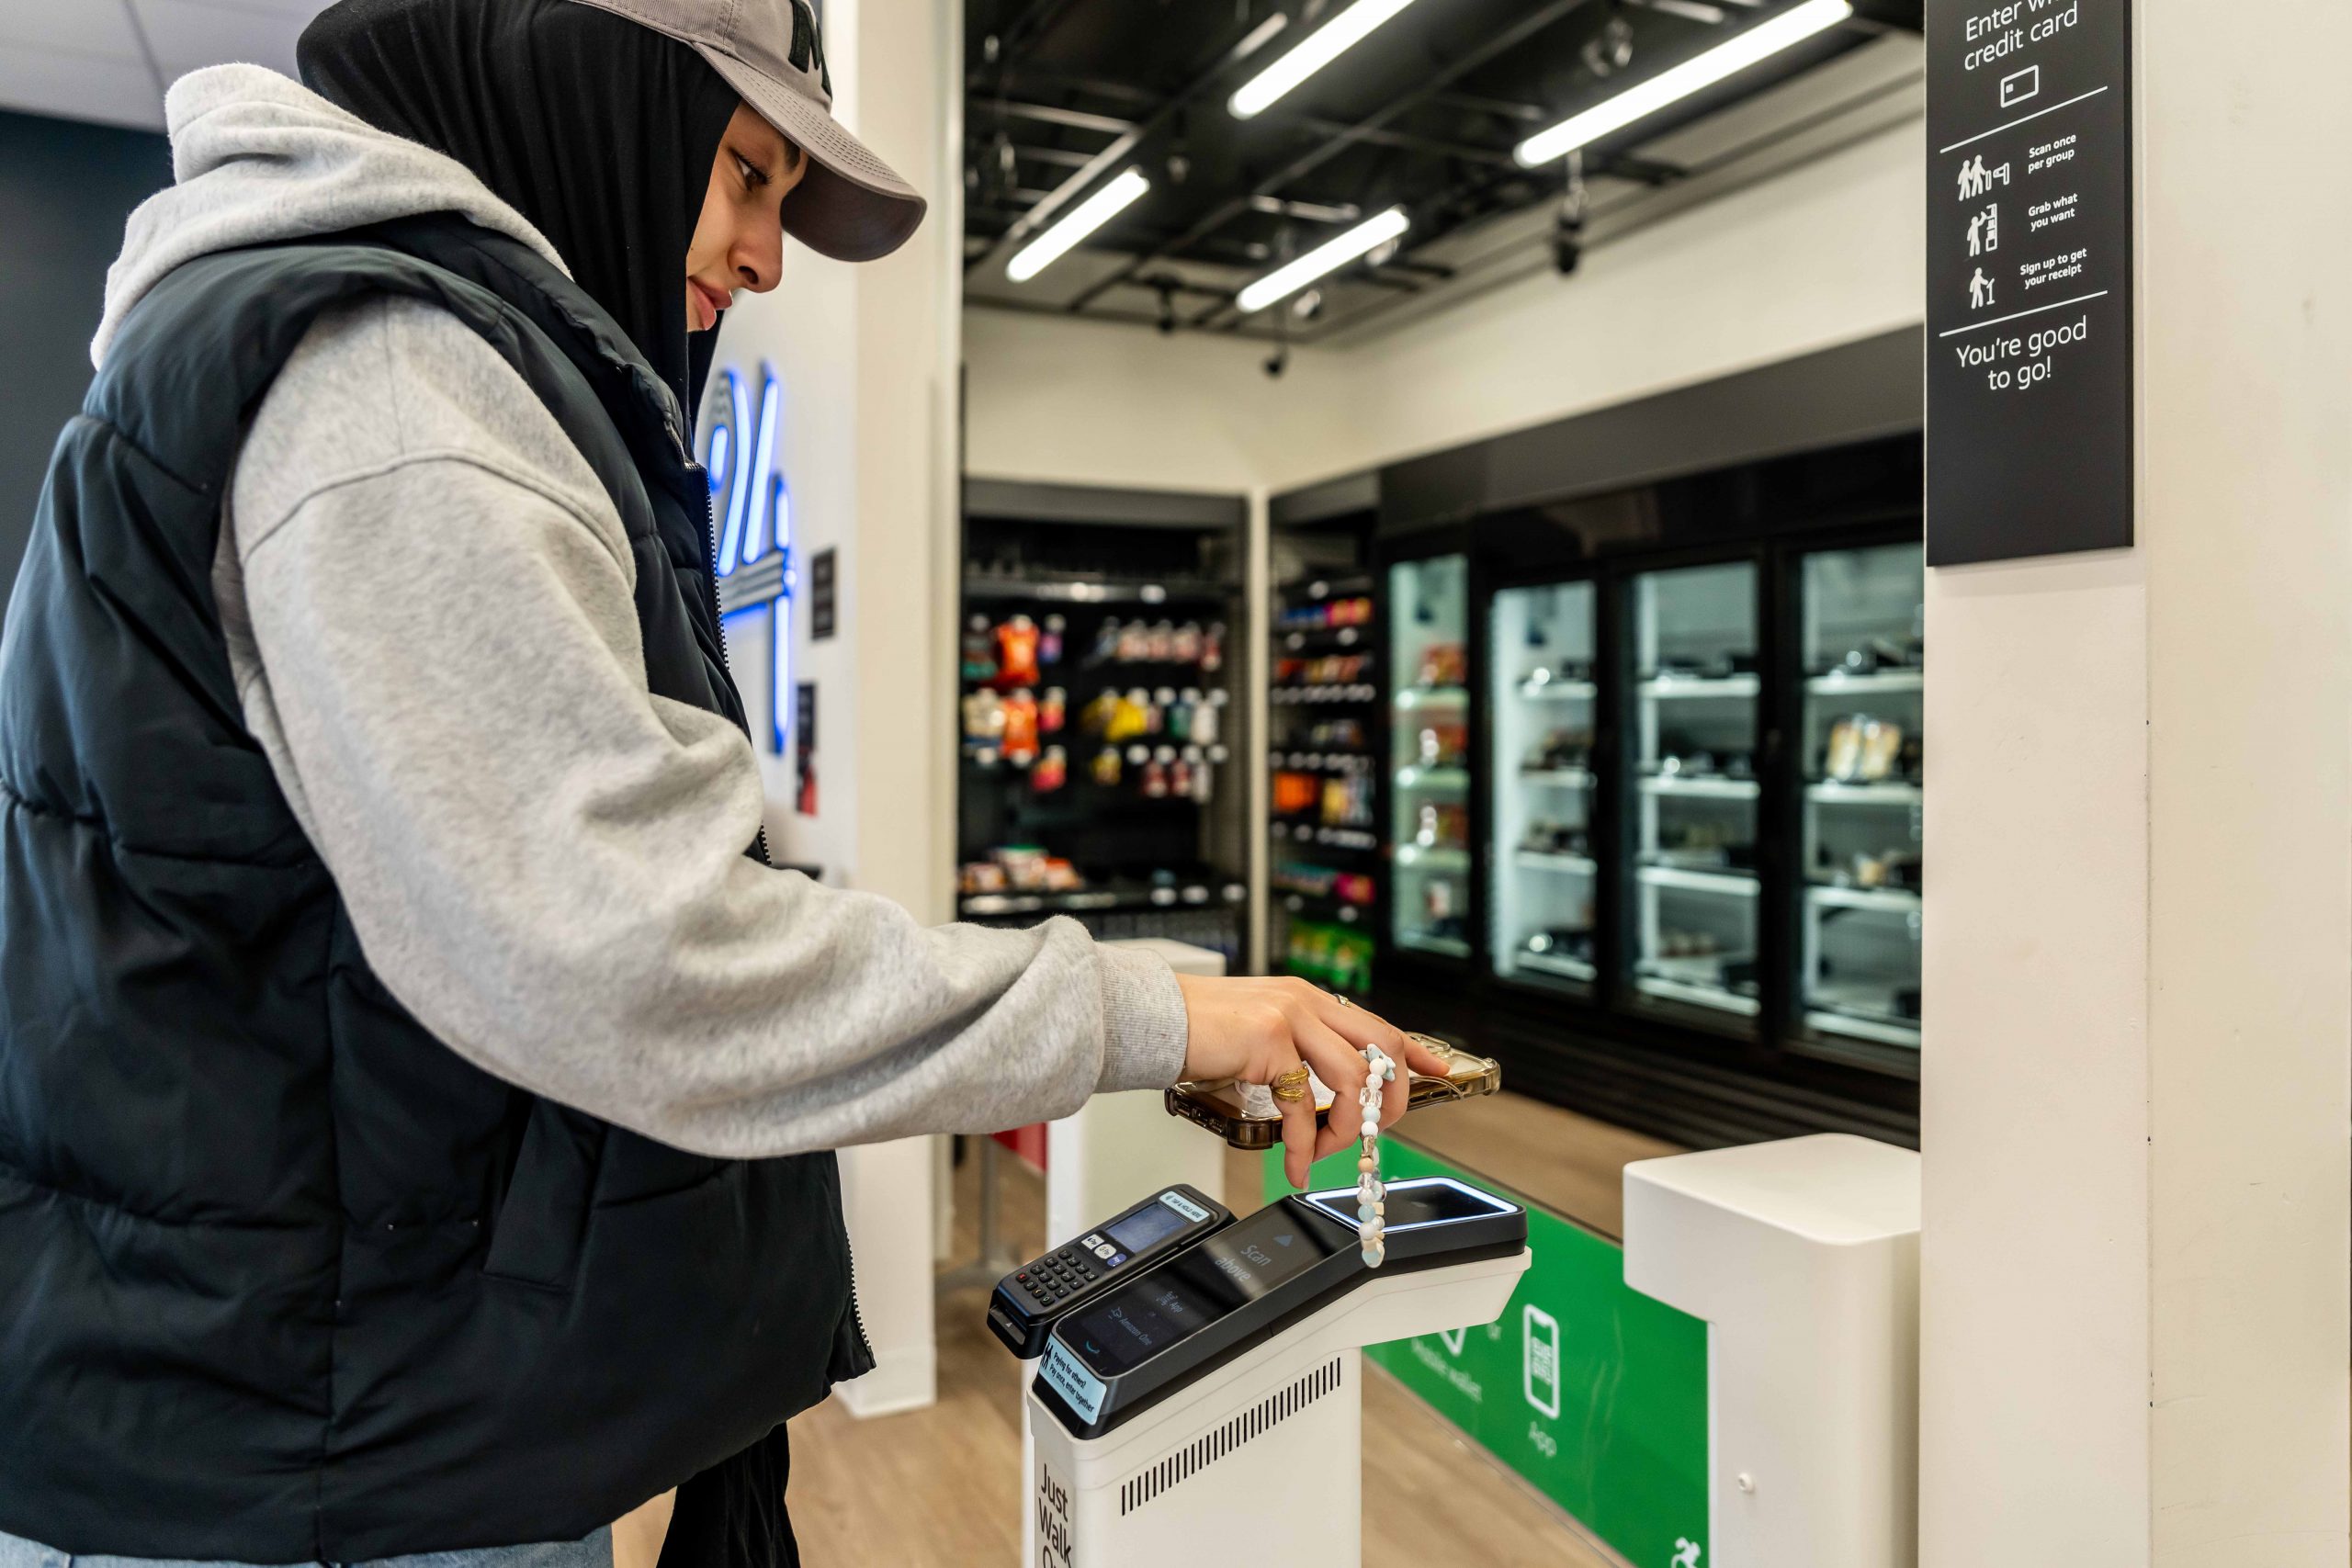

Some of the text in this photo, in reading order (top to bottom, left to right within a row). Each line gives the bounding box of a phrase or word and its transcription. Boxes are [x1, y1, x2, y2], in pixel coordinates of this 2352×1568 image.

[1964, 0, 2077, 71] credit card
[1966, 1, 2022, 41] Enter
[2028, 148, 2075, 174] per group
[2029, 134, 2076, 158] Scan once
[2029, 193, 2077, 217] Grab what
[2030, 208, 2075, 231] you want
[2020, 248, 2087, 276] Sign up to get
[2024, 263, 2082, 289] your receipt
[1956, 314, 2086, 367] You're good
[1987, 355, 2052, 390] to go!
[1215, 1257, 1251, 1282] above
[1240, 1245, 1272, 1267] Scan
[1053, 1351, 1067, 1371] Paying
[1071, 1371, 1087, 1390] others?
[1049, 1363, 1057, 1377] Pay
[1066, 1382, 1077, 1396] enter
[1075, 1391, 1095, 1413] together
[1040, 1462, 1069, 1523] Just
[1038, 1497, 1071, 1568] Walk
